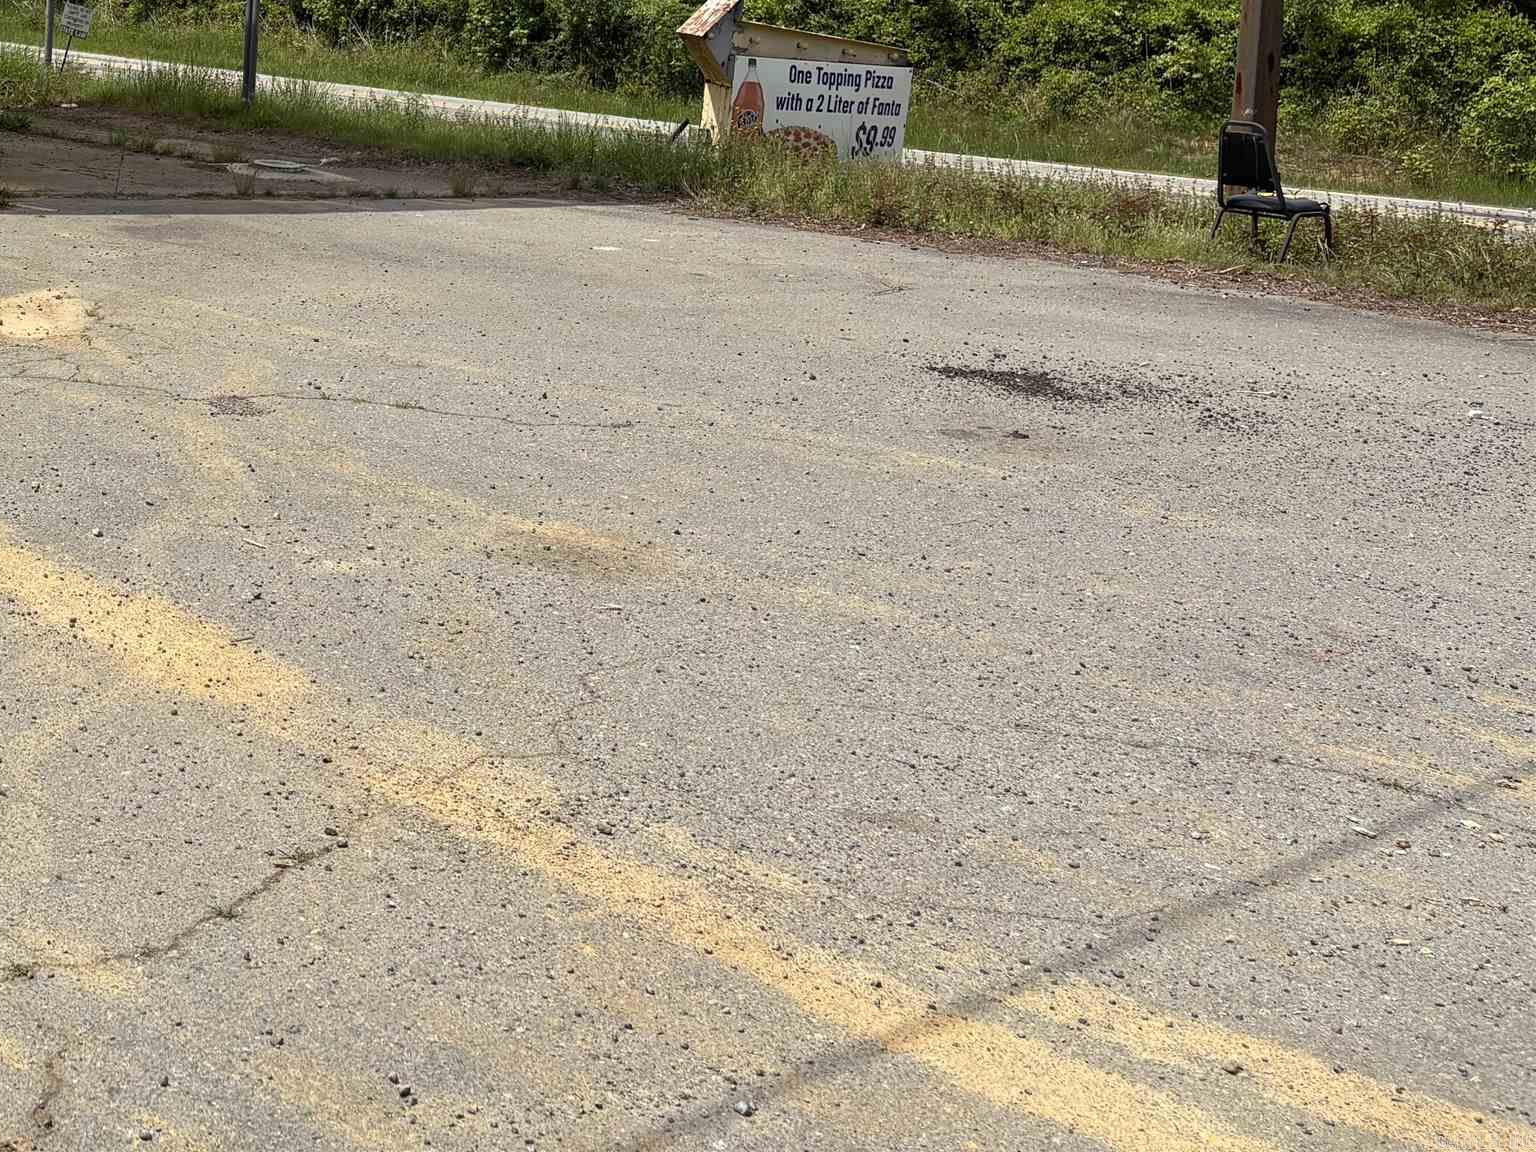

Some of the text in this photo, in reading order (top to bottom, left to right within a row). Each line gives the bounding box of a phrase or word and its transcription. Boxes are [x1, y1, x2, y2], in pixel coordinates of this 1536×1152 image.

[789, 64, 894, 93] One Topping Pizza
[775, 93, 902, 117] with a 2 Liter of Fanta
[852, 120, 897, 159] $9.99
